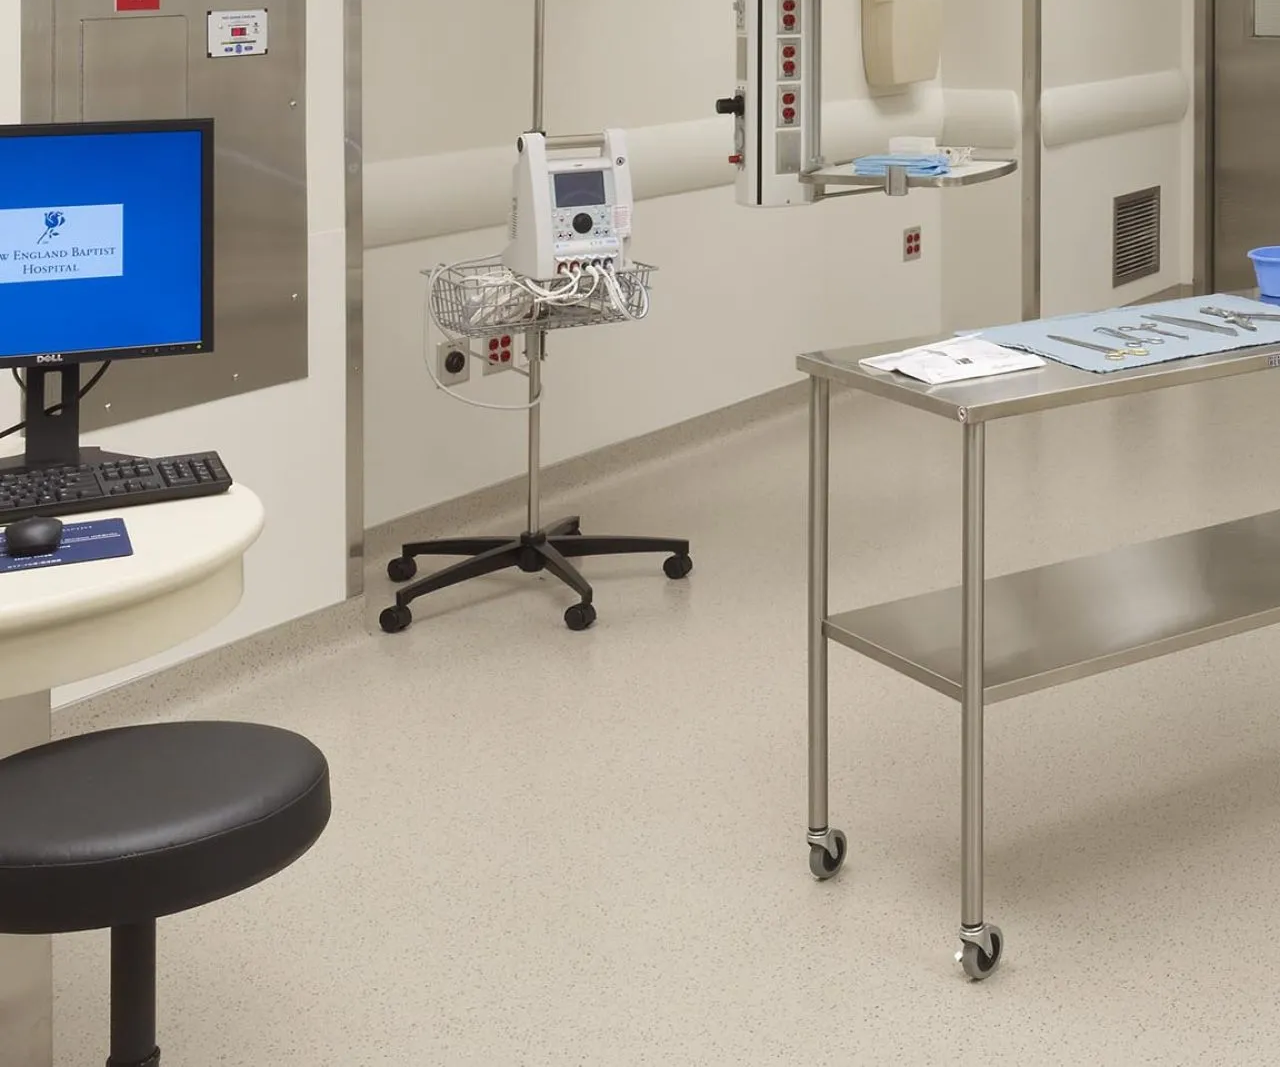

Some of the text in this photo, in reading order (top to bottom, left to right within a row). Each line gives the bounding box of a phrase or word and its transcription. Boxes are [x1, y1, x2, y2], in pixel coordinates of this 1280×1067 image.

[13, 249, 68, 261] ENGLAND
[72, 246, 116, 257] BAPTIST
[23, 263, 79, 275] HOSPITAL
[37, 354, 63, 363] DELL
